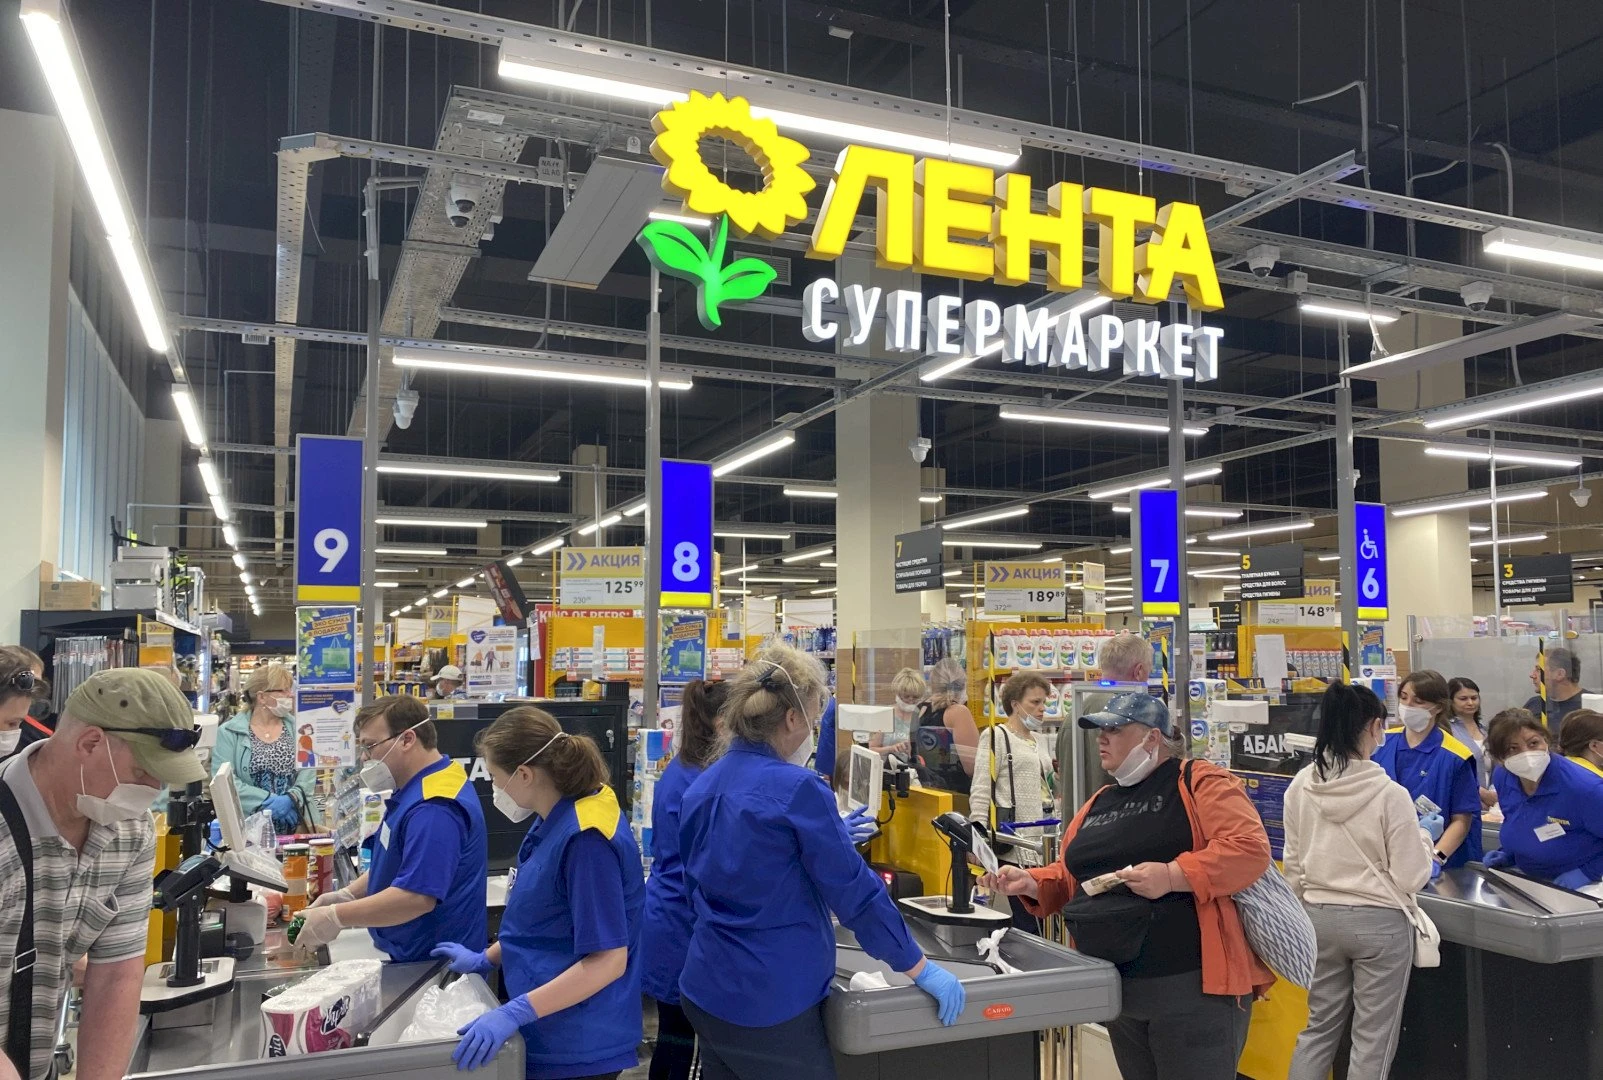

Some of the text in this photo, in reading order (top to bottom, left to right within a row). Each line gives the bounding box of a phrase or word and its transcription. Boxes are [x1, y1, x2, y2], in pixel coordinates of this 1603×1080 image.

[805, 145, 1225, 311] ЛЕНТА
[802, 277, 1225, 381] СУПЕРМАРКЕТ
[314, 528, 349, 573] 9
[896, 541, 902, 558] 7
[590, 554, 640, 569] АКЦИЯ
[672, 541, 700, 582] 8
[1241, 555, 1251, 570] 5
[1503, 563, 1514, 578] 3
[1013, 568, 1061, 580] АКЦИЯ
[1150, 559, 1169, 593] 7
[1303, 586, 1331, 597] ЦИЯ
[1362, 568, 1379, 599] 6
[1234, 603, 1240, 612] 2
[1243, 734, 1287, 754] АБАК
